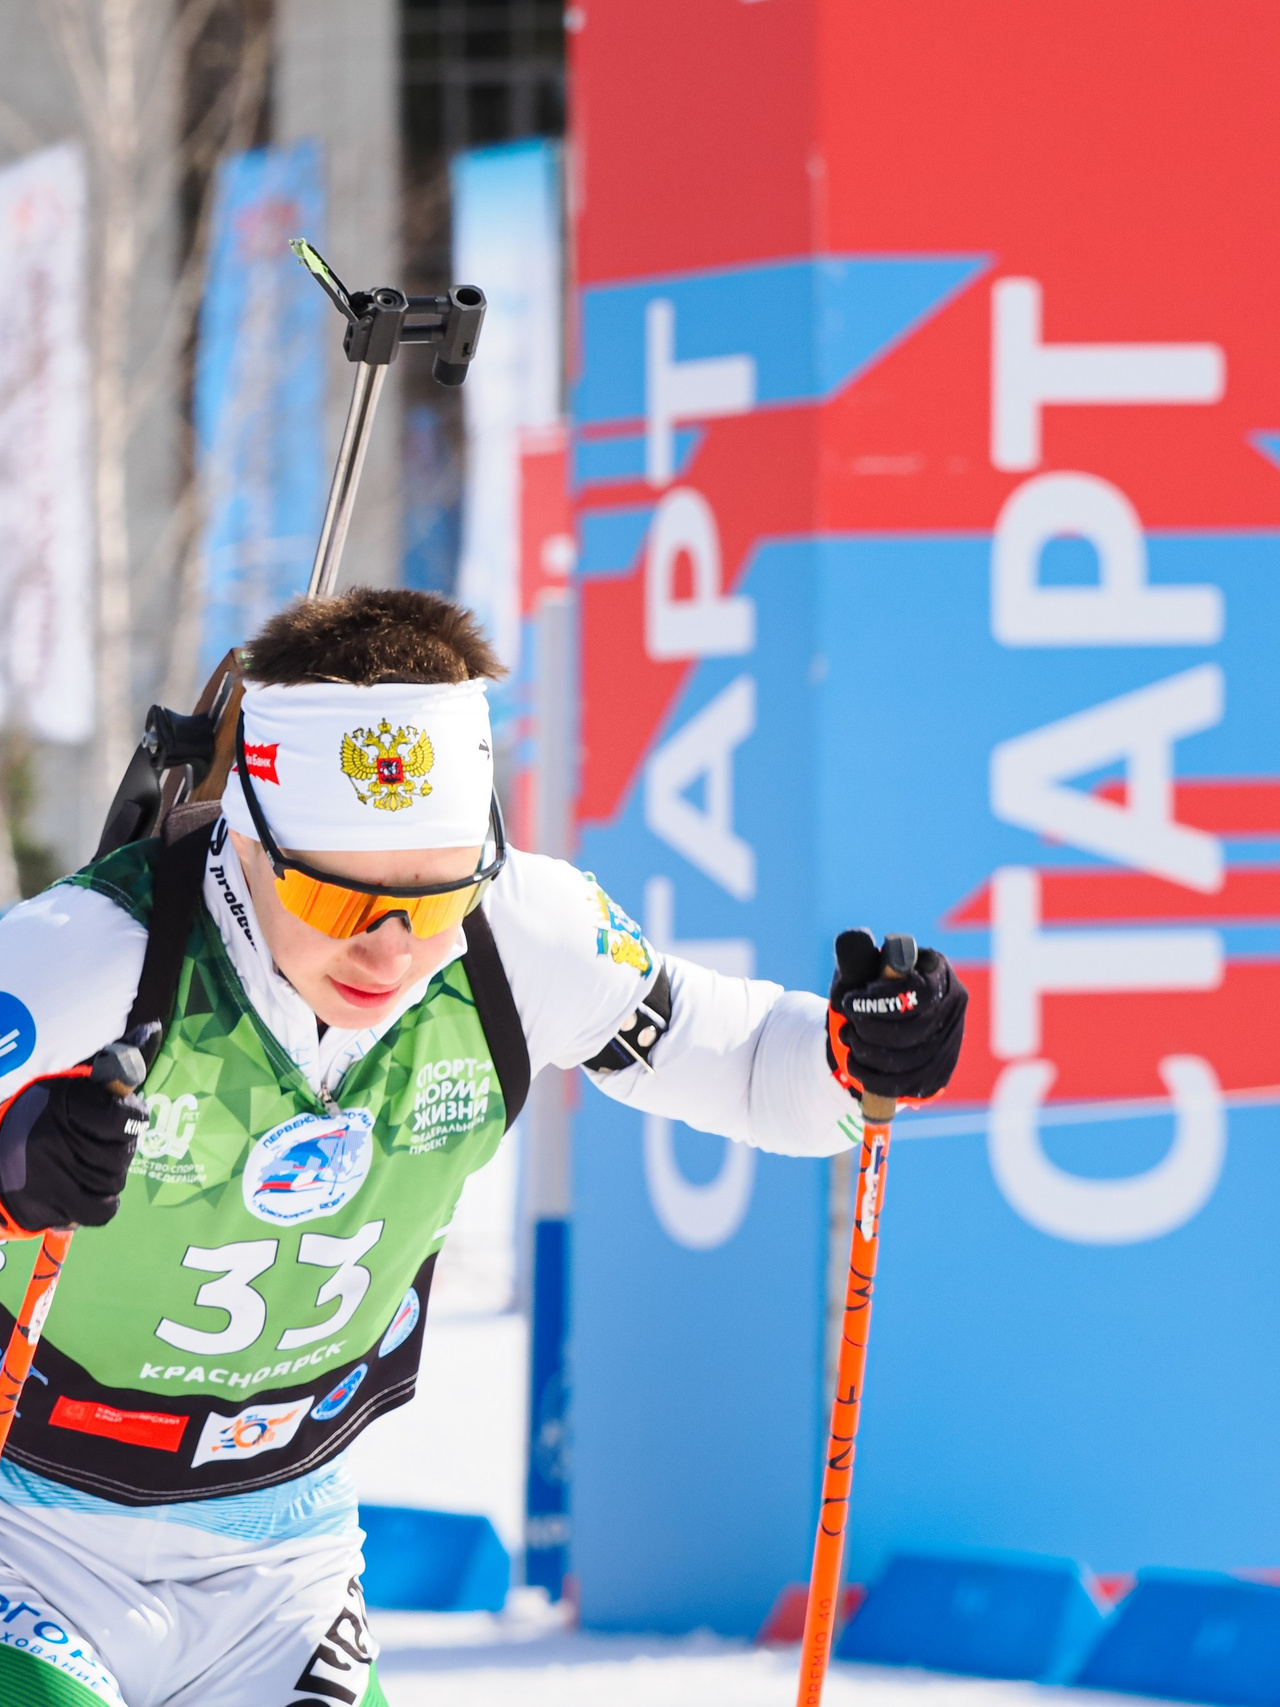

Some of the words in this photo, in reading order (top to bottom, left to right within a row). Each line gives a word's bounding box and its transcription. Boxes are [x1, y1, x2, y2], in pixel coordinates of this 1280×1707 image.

[988, 276, 1227, 1247] СТАРТ
[412, 1096, 489, 1132] ЖИЗНИ
[414, 1075, 491, 1111] НОРМА
[409, 1135, 448, 1155] ПРОЕКТ
[153, 1218, 385, 1356] 33
[139, 1339, 349, 1389] КРАСНОЯРСК
